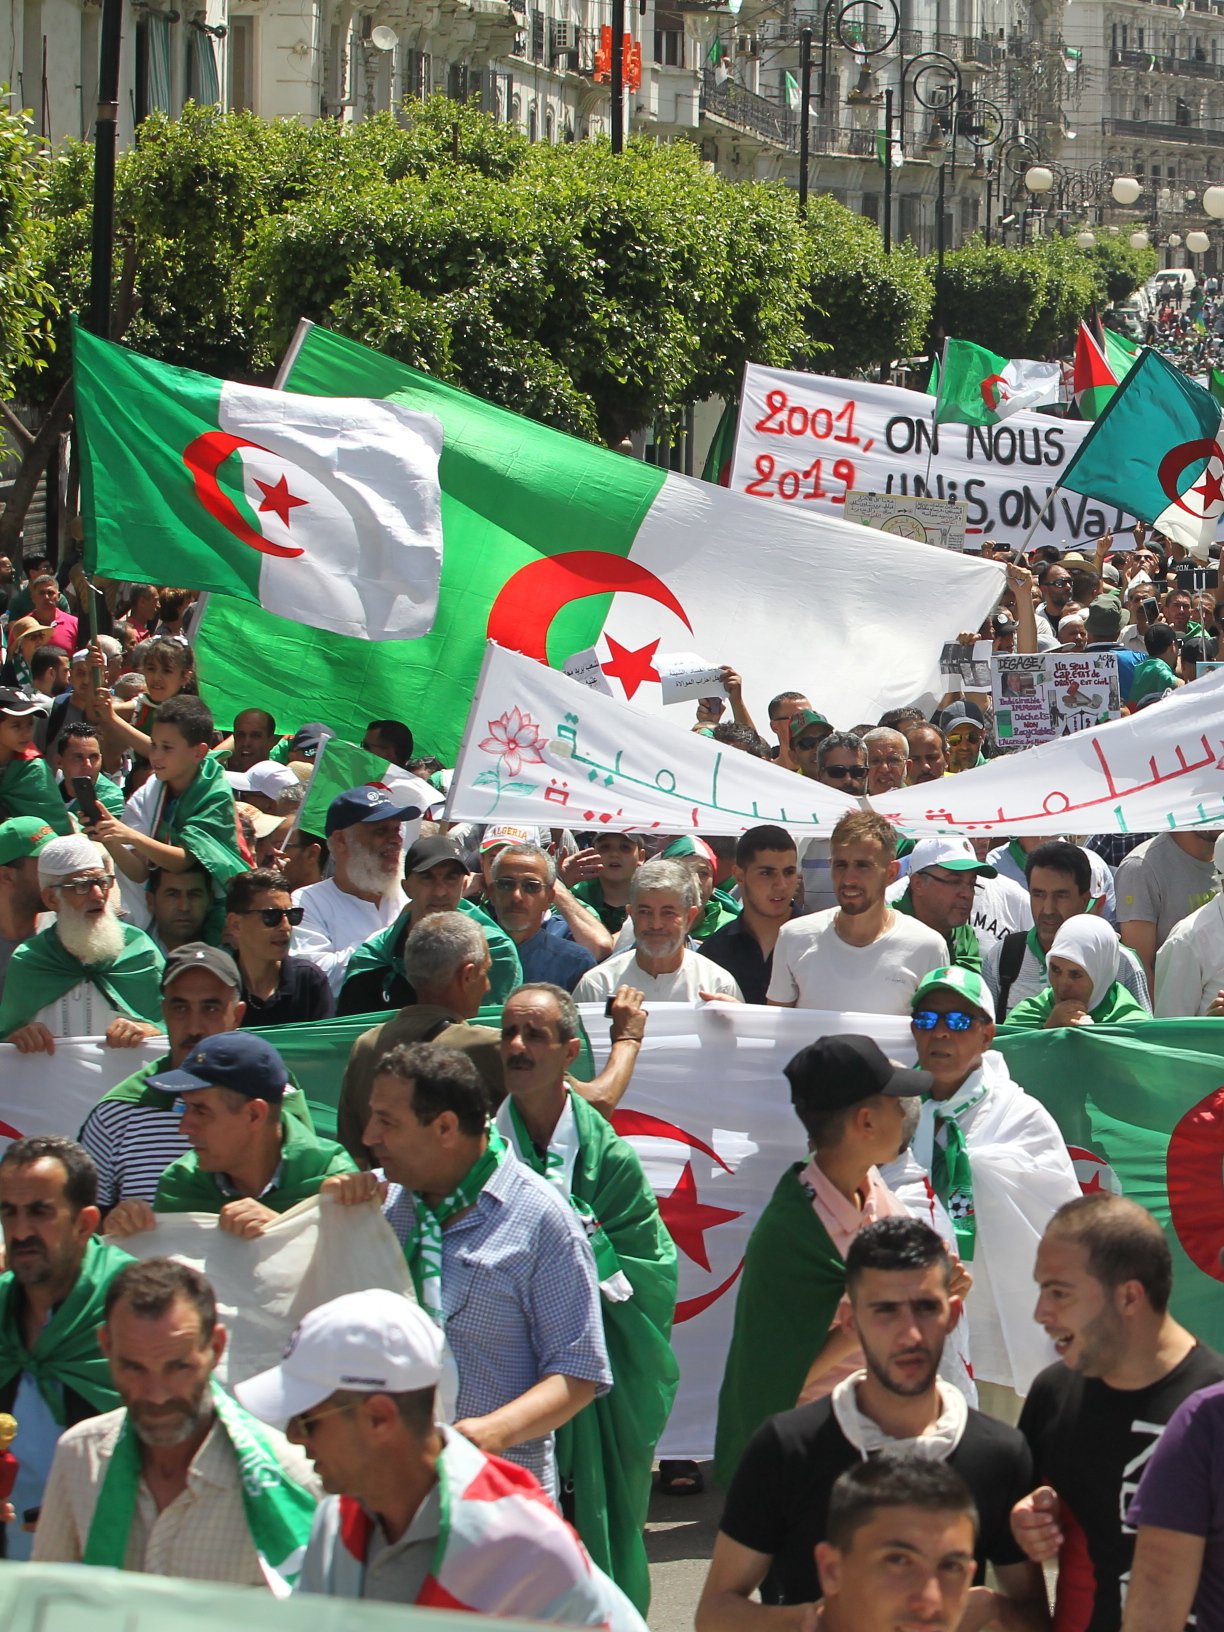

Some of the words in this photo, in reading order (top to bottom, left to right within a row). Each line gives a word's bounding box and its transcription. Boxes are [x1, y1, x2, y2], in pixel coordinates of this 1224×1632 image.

[755, 390, 874, 453] 2001,
[886, 410, 939, 455] ON
[966, 425, 1065, 467] NOUS
[744, 454, 855, 504] 2019
[557, 711, 820, 825] سلمية
[925, 733, 1217, 831] سلمية
